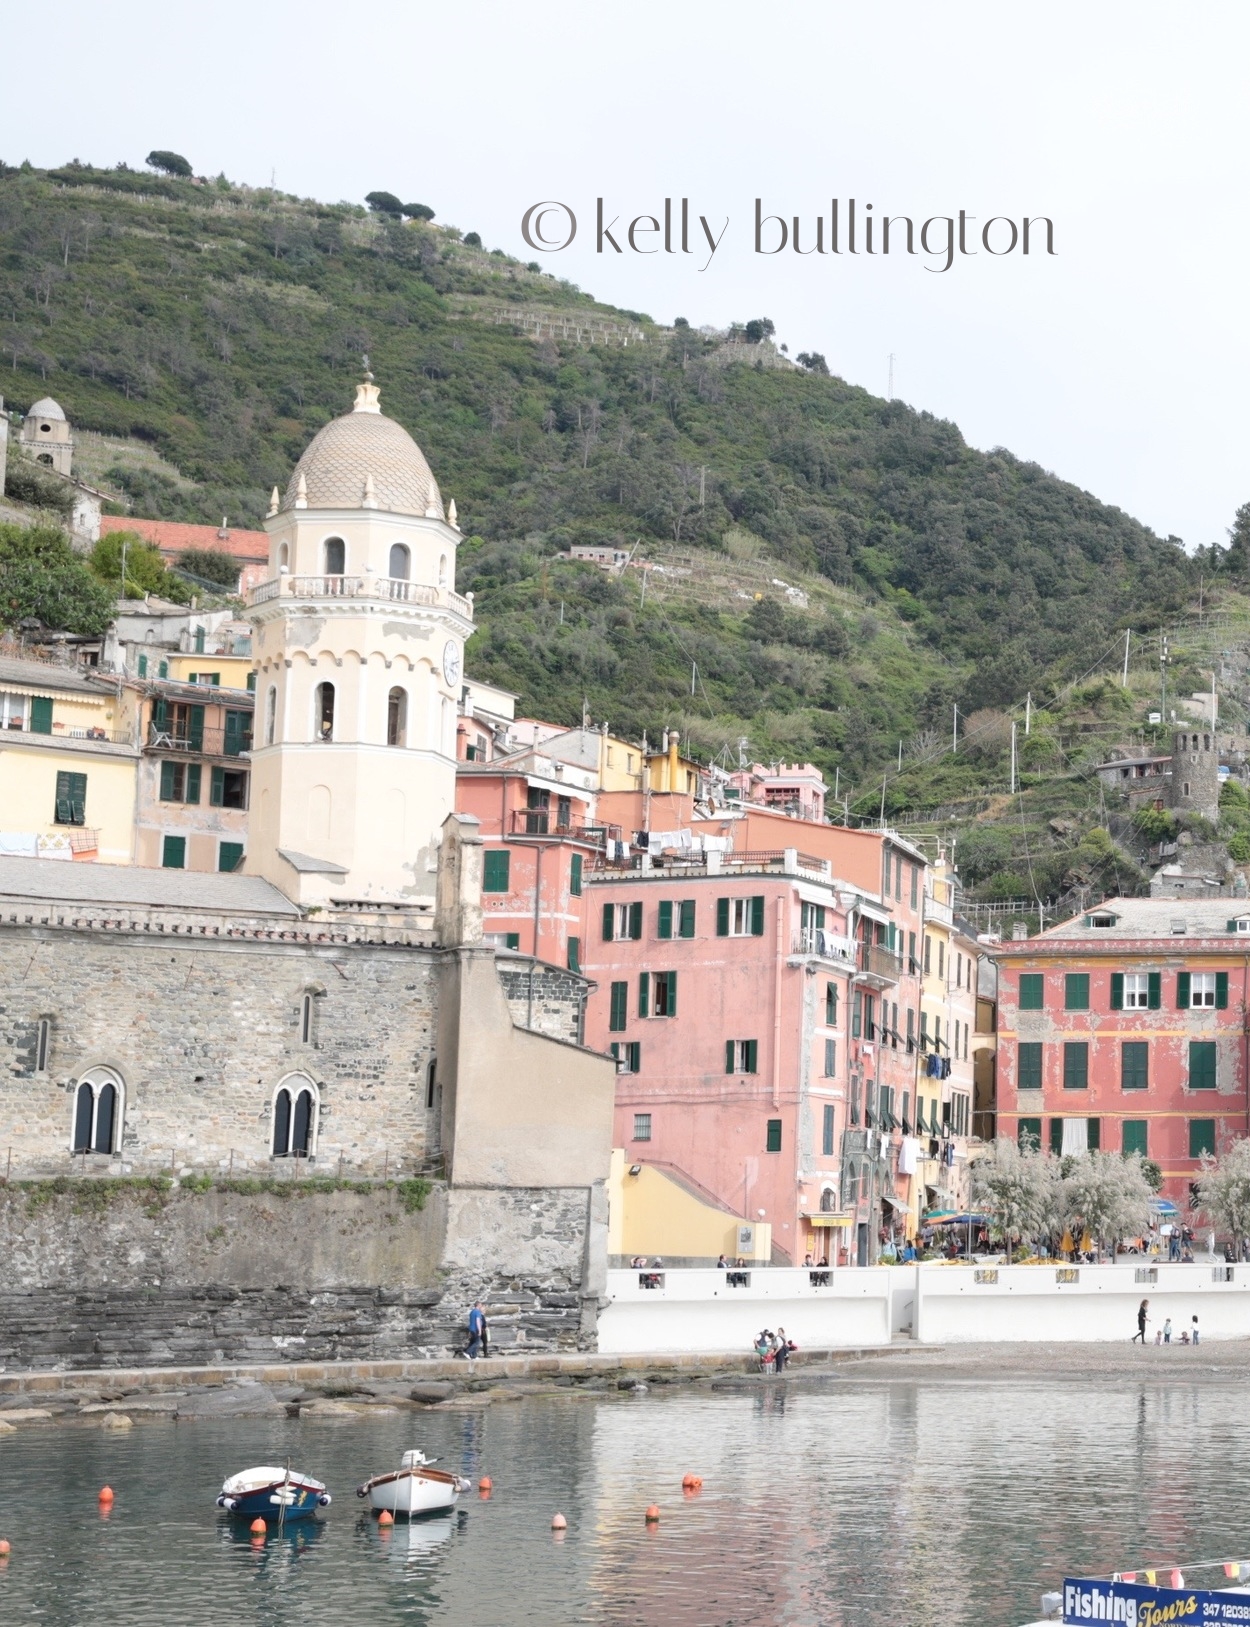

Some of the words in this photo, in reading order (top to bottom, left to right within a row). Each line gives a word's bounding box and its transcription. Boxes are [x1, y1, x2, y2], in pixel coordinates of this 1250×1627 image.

[1065, 1585, 1137, 1627] Fishing
[1138, 1595, 1198, 1627] Tours
[1203, 1603, 1220, 1617] 347
